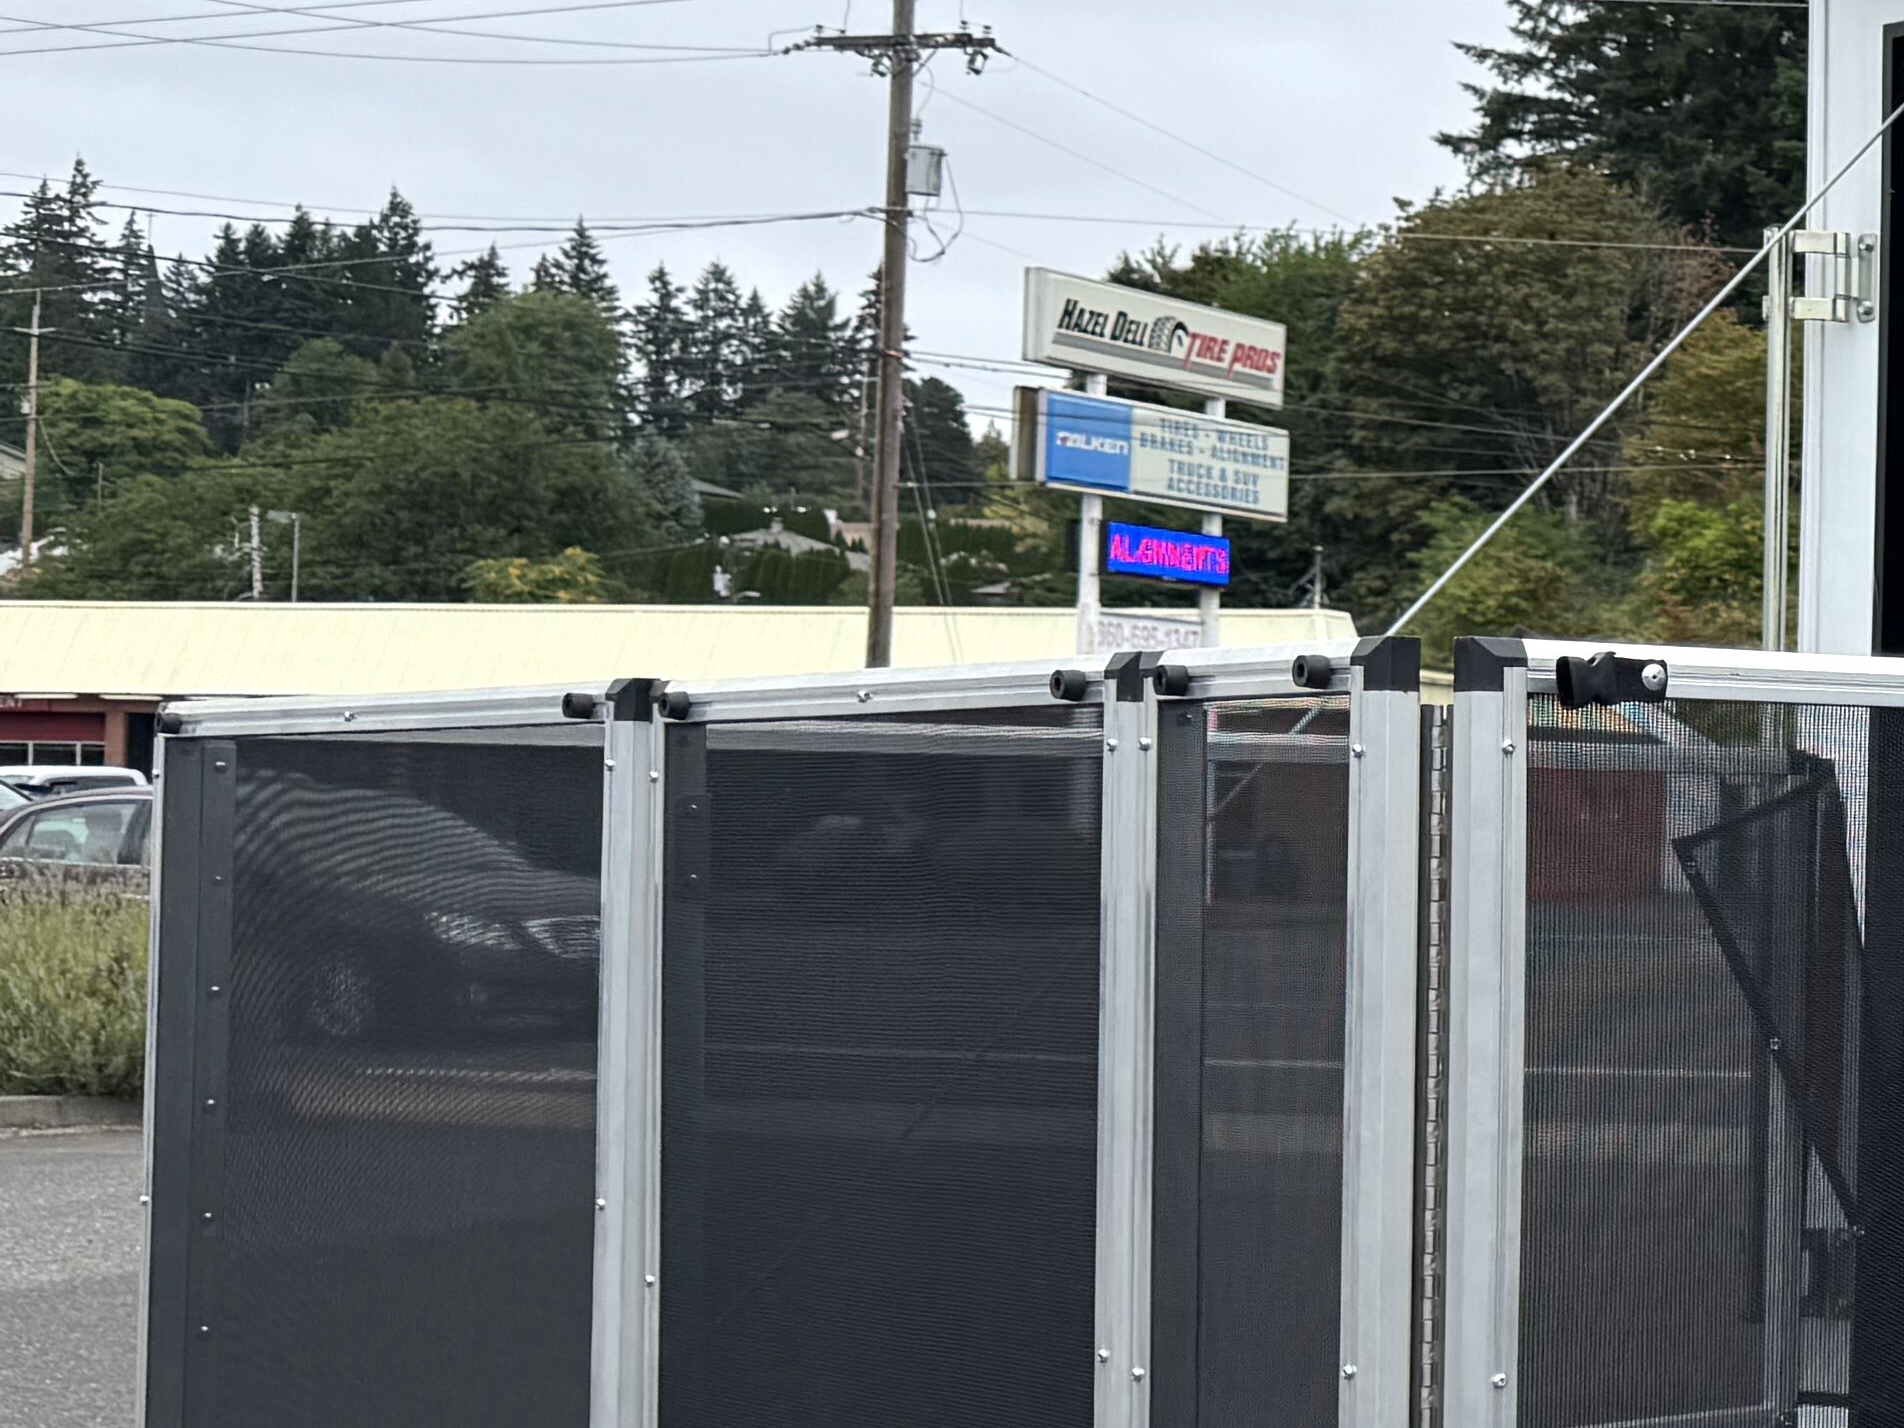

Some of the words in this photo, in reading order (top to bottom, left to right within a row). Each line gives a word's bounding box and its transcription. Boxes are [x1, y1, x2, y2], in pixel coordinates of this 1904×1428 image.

[1057, 298, 1109, 340] HAZEL
[1110, 310, 1148, 347] DELL
[1183, 332, 1231, 372] TIRE
[1226, 342, 1282, 381] PROS
[1140, 432, 1194, 456] BRAKES
[1211, 444, 1284, 471] ALIGNMENT
[1216, 429, 1269, 450] WHEELS
[1168, 459, 1214, 480] TRUCK
[1234, 469, 1260, 487] SUV
[1167, 476, 1260, 504] ACCESSORIES
